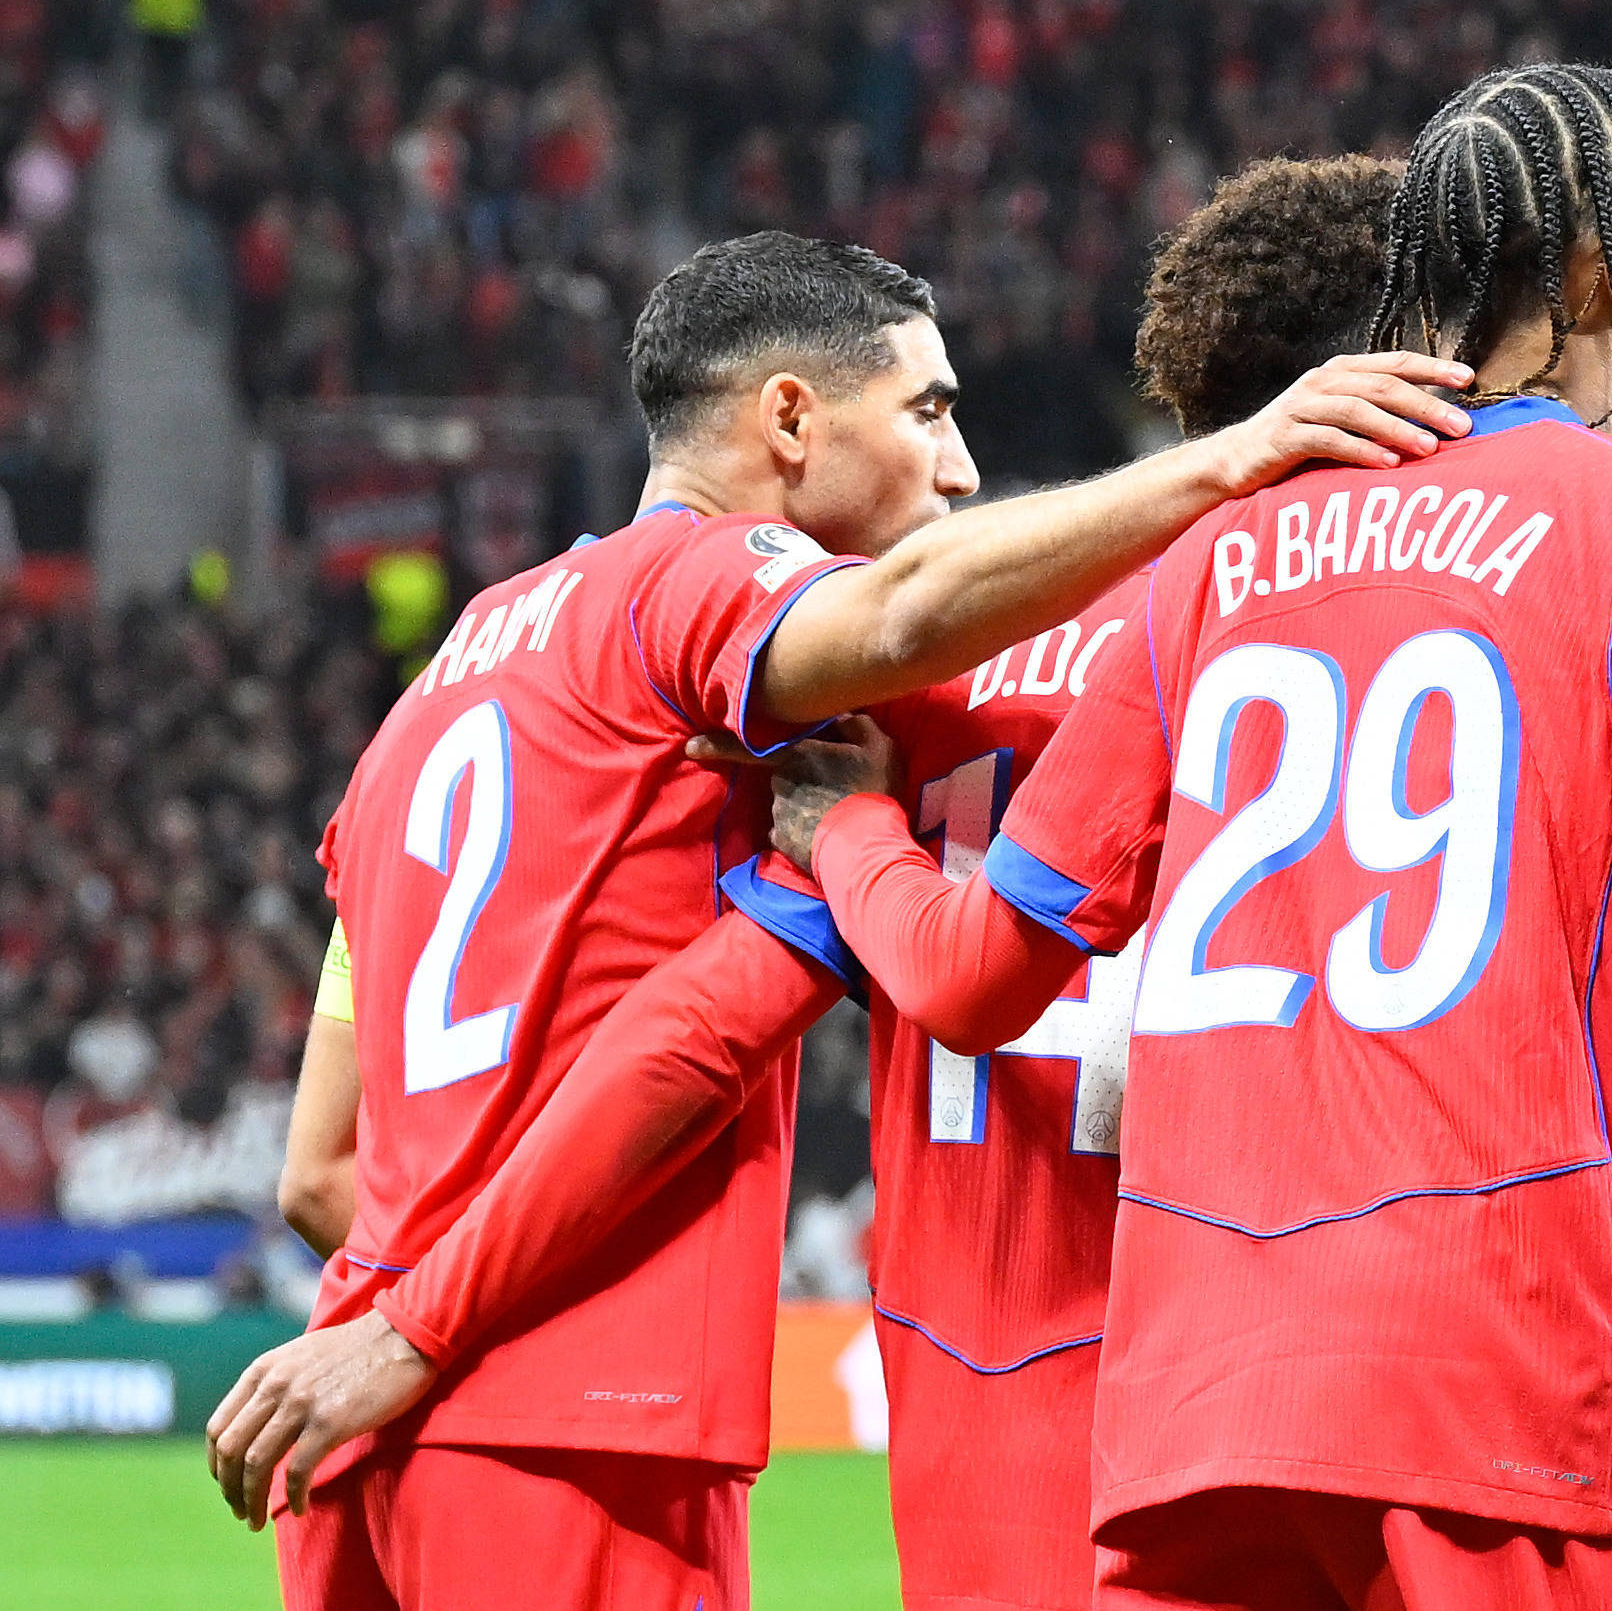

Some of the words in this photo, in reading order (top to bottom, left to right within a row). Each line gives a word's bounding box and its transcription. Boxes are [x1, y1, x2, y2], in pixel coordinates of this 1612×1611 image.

[1213, 485, 1555, 618] B.BARCOLA
[404, 699, 521, 1096] 2
[1132, 629, 1521, 1037] 29
